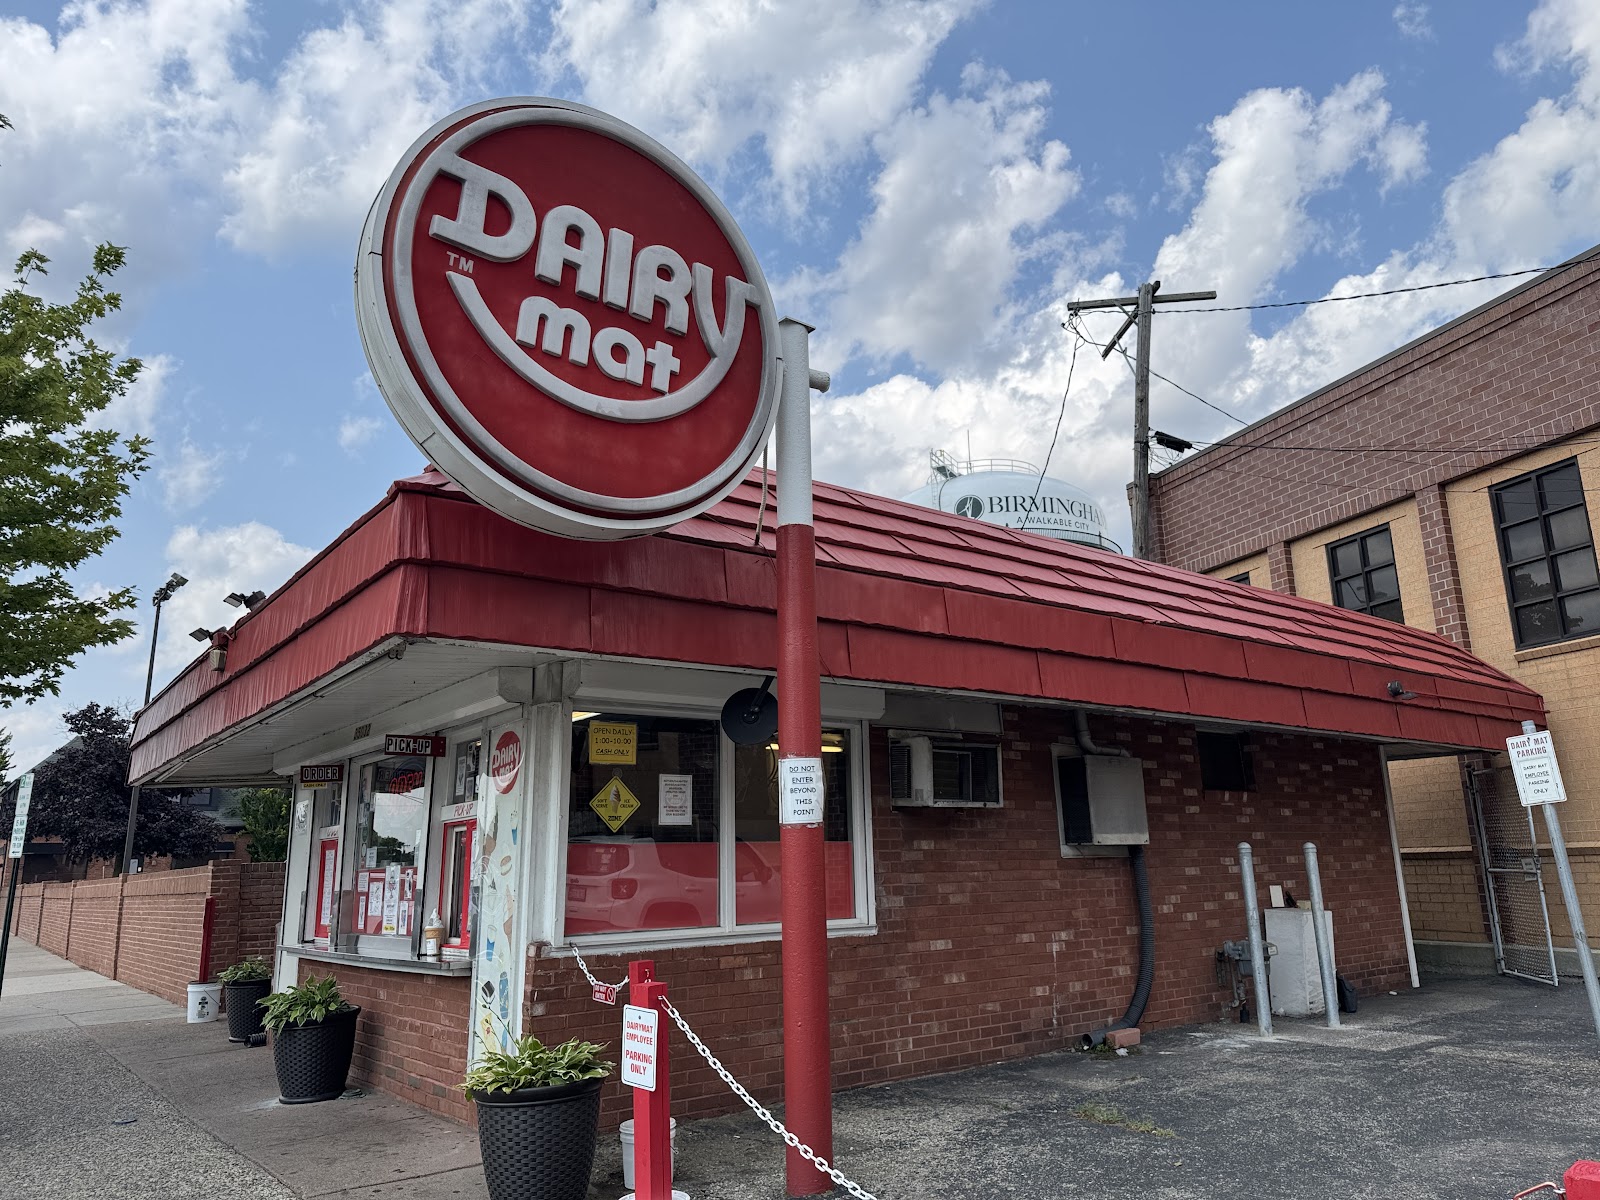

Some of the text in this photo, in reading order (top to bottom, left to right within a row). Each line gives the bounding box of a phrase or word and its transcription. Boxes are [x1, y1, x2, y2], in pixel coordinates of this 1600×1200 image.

[429, 153, 761, 358] DAIRY
[446, 250, 474, 274] TM
[1027, 516, 1072, 528] WALKABLE
[1075, 521, 1090, 531] CITY
[612, 728, 632, 736] DAILY
[386, 737, 431, 754] PICK-UP
[595, 737, 632, 745] 1:00-10:00
[1511, 736, 1548, 749] DAIRY MAT
[492, 742, 520, 769] DAIRY
[596, 748, 612, 756] CASH
[1517, 747, 1547, 757] PARKING
[303, 767, 339, 780] ORDER
[1524, 771, 1550, 779] EMPLOYEE
[453, 803, 474, 817] PICK-UP
[627, 1021, 653, 1034] DAIRYMAT
[626, 1033, 653, 1045] EMPLOYEE
[625, 1050, 652, 1064] PARKING
[631, 1063, 646, 1075] ONLY
